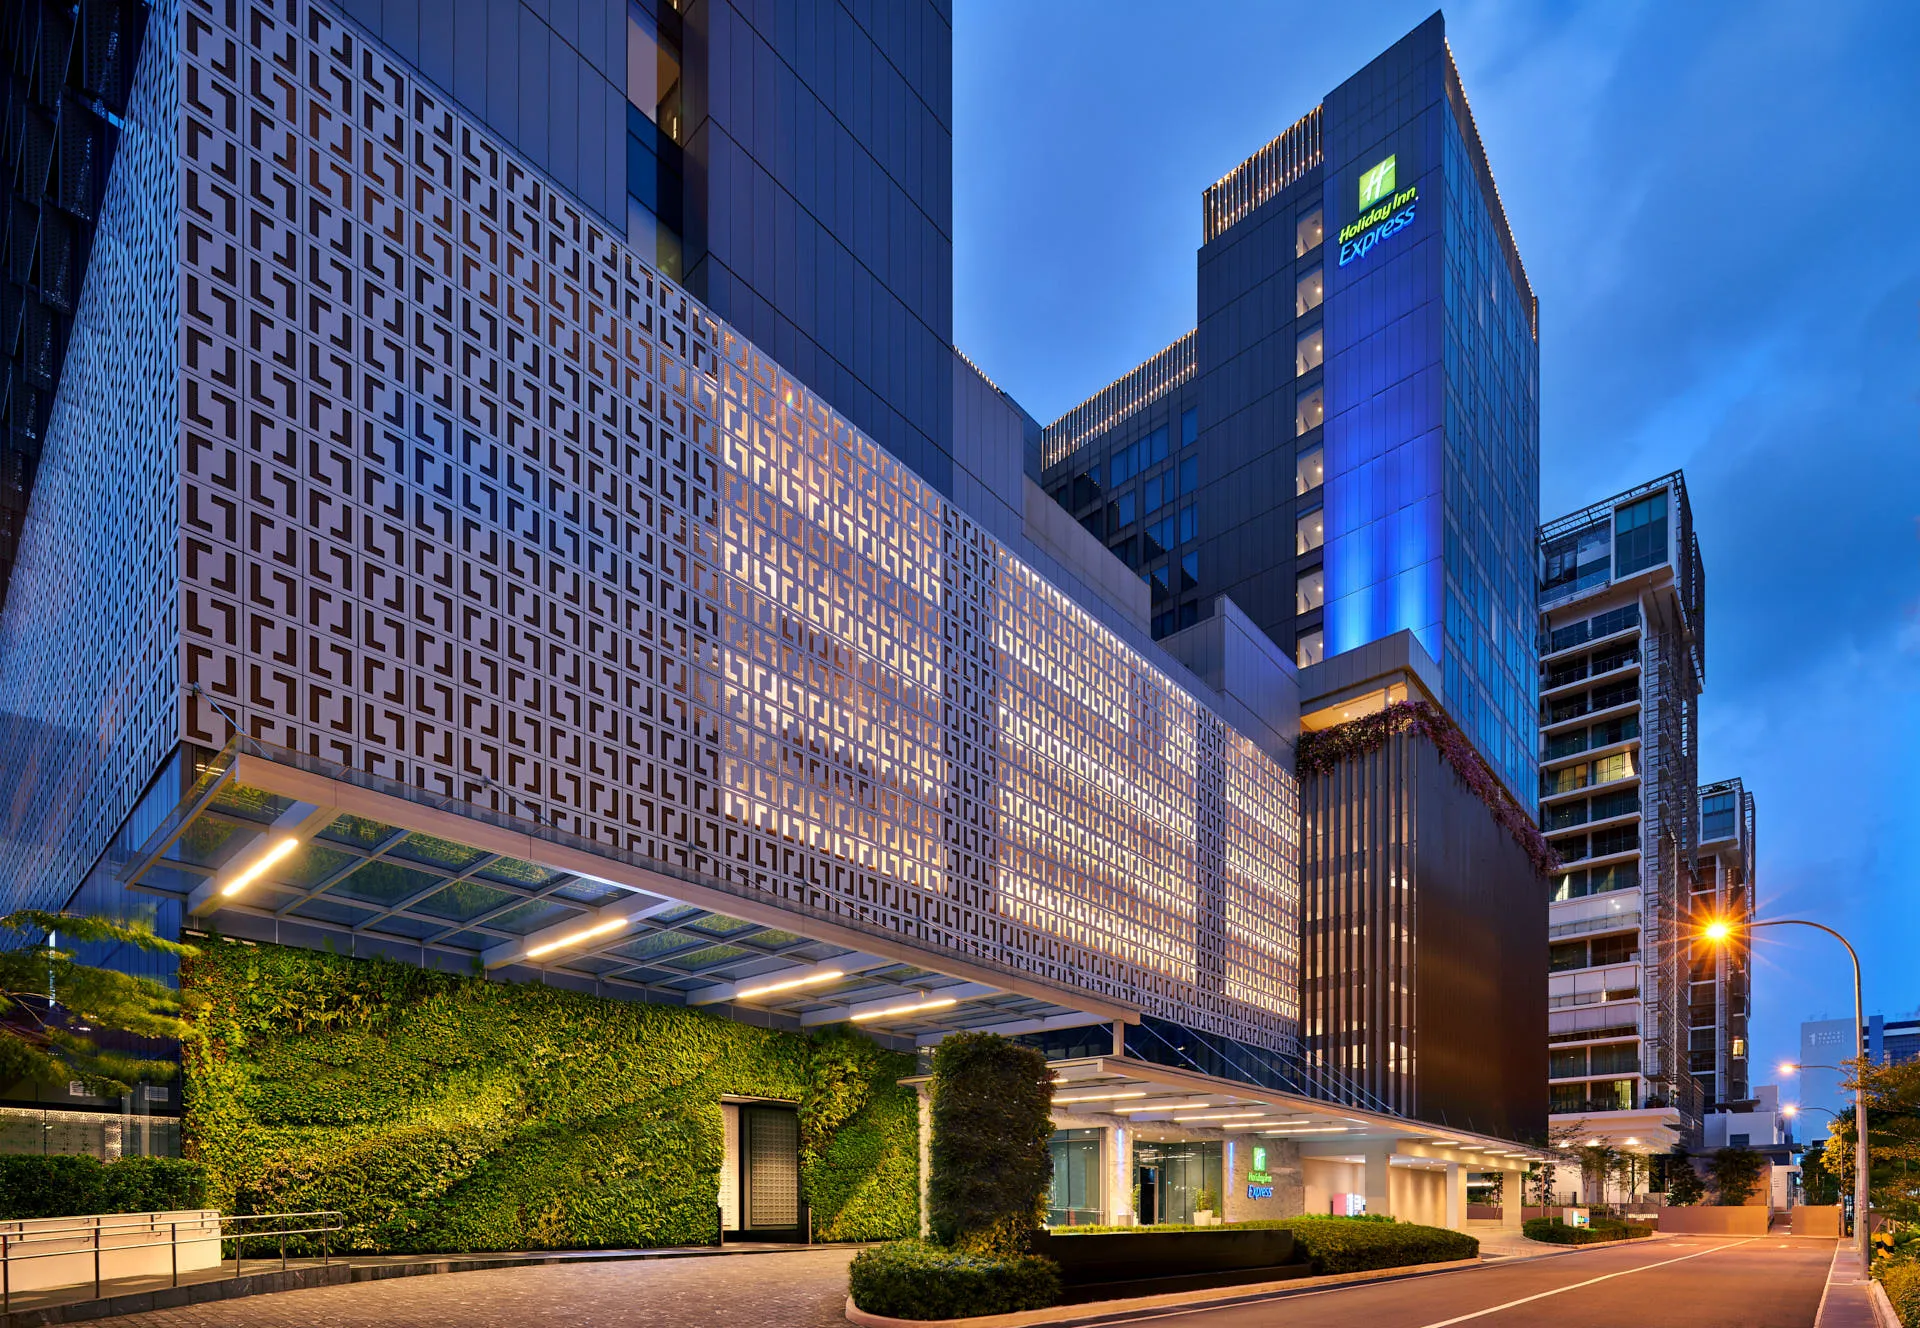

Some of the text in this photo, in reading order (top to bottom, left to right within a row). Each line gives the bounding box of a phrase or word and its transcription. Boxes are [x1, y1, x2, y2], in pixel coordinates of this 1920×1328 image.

[1339, 187, 1416, 244] Holiday Inn
[1339, 204, 1416, 267] Express
[1247, 1185, 1273, 1200] Express
